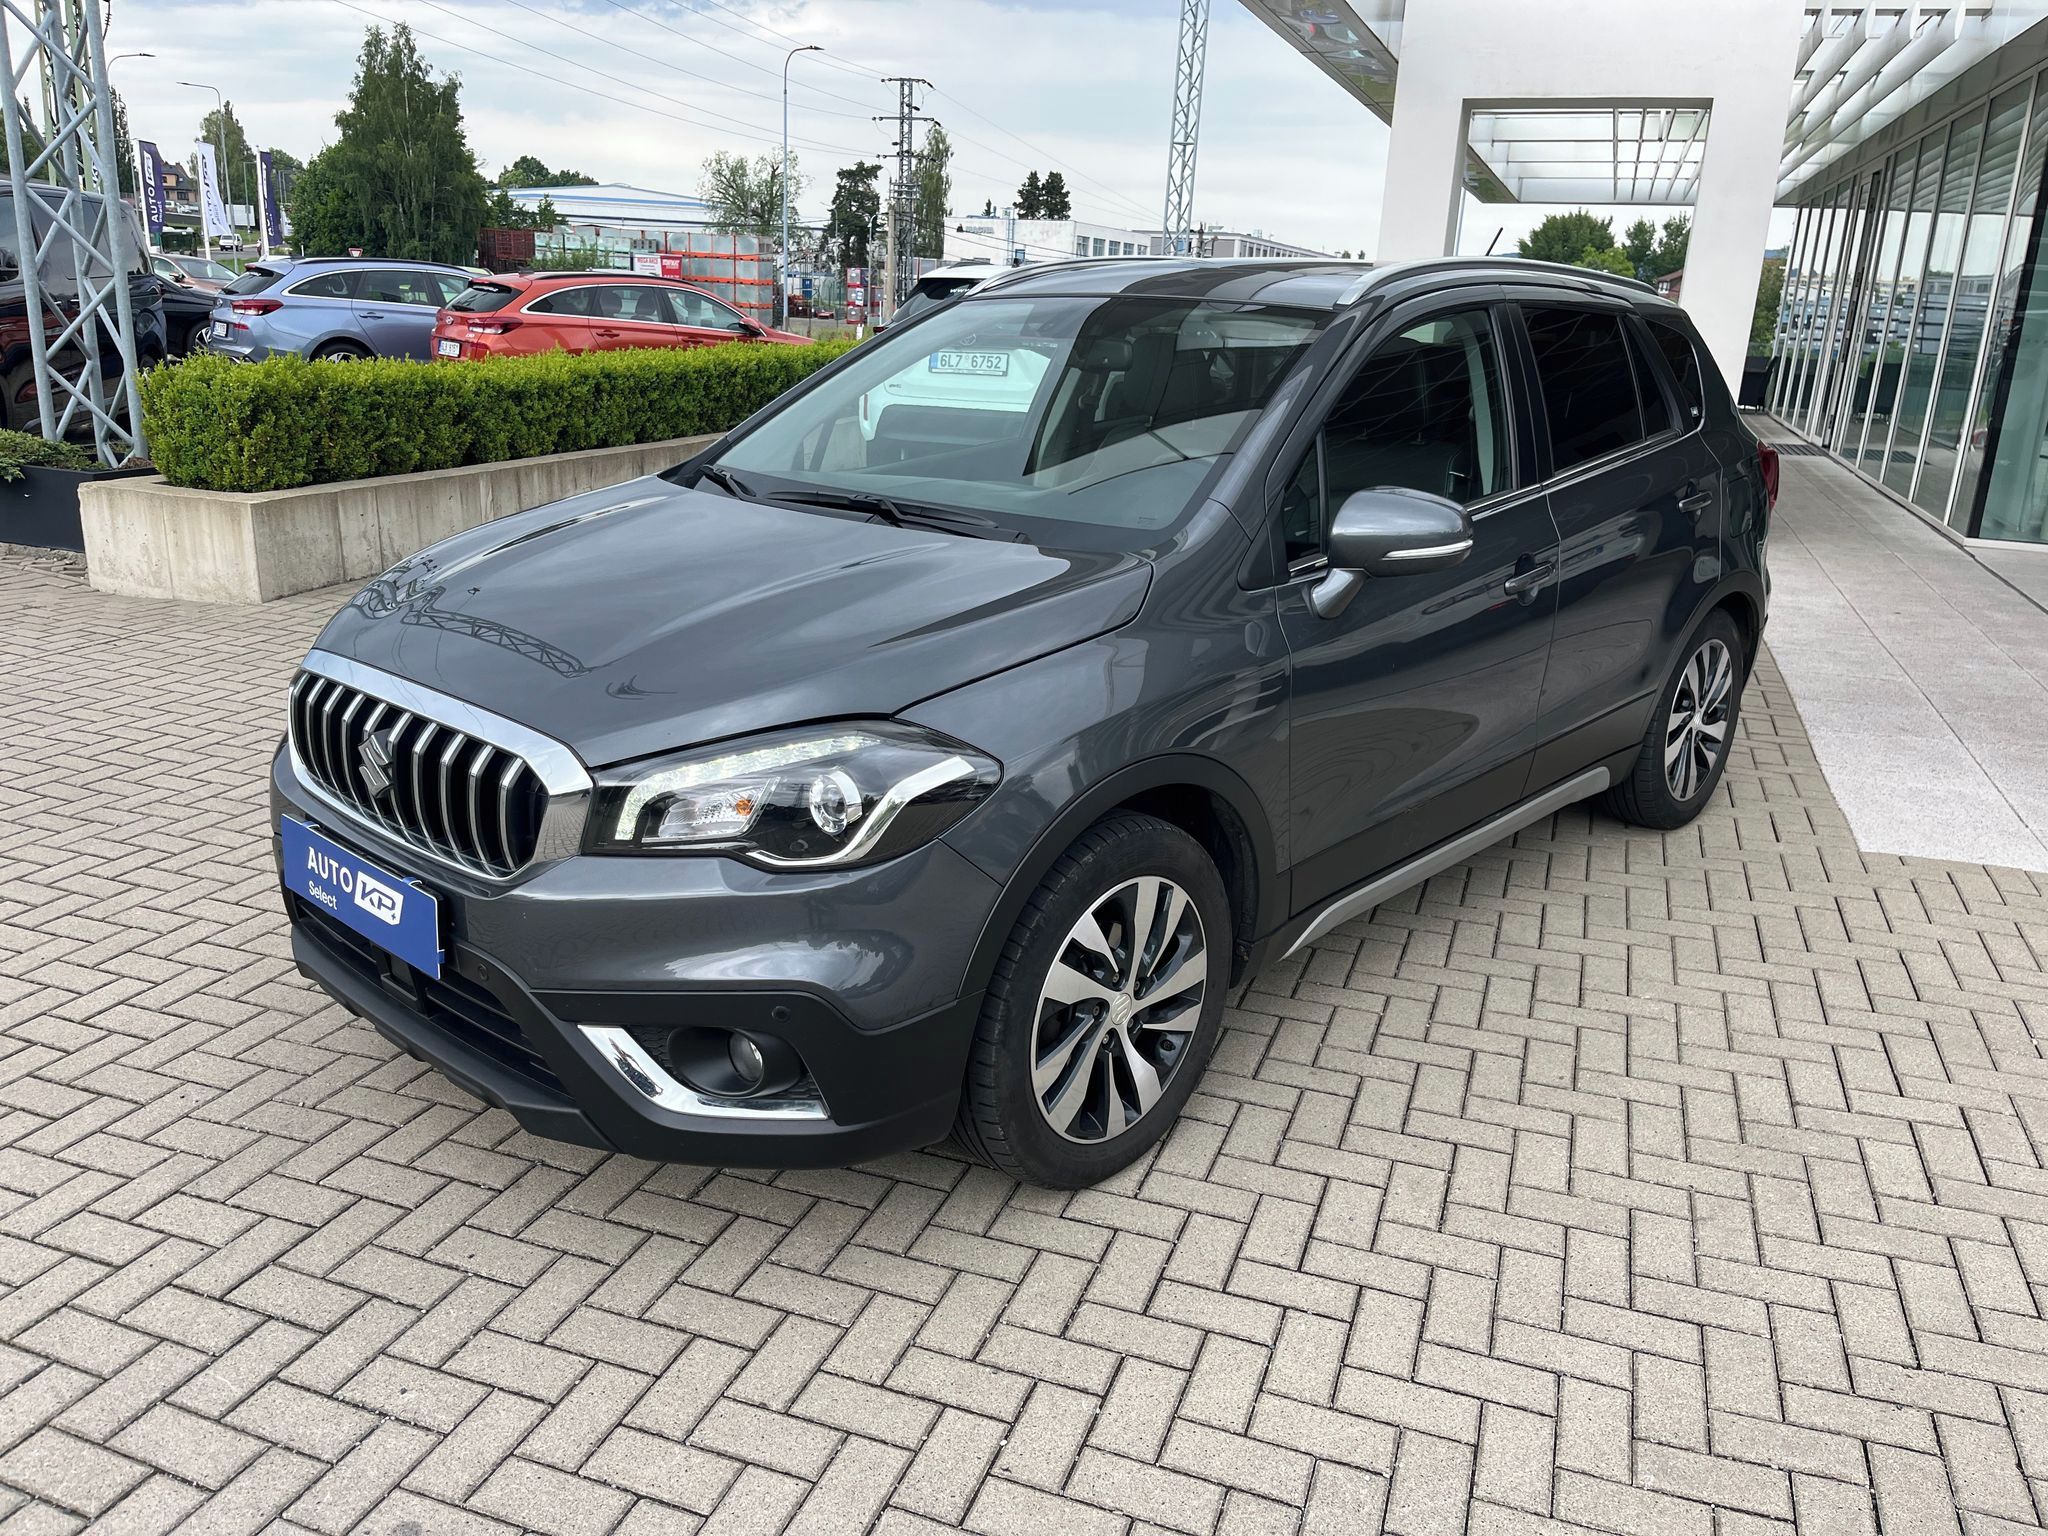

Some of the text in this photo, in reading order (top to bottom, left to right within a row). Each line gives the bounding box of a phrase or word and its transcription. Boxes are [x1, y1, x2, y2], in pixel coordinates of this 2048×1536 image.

[148, 187, 159, 223] AUTO
[940, 354, 1002, 369] 6L7 6752
[307, 846, 353, 893] AUTO
[308, 880, 338, 910] Select
